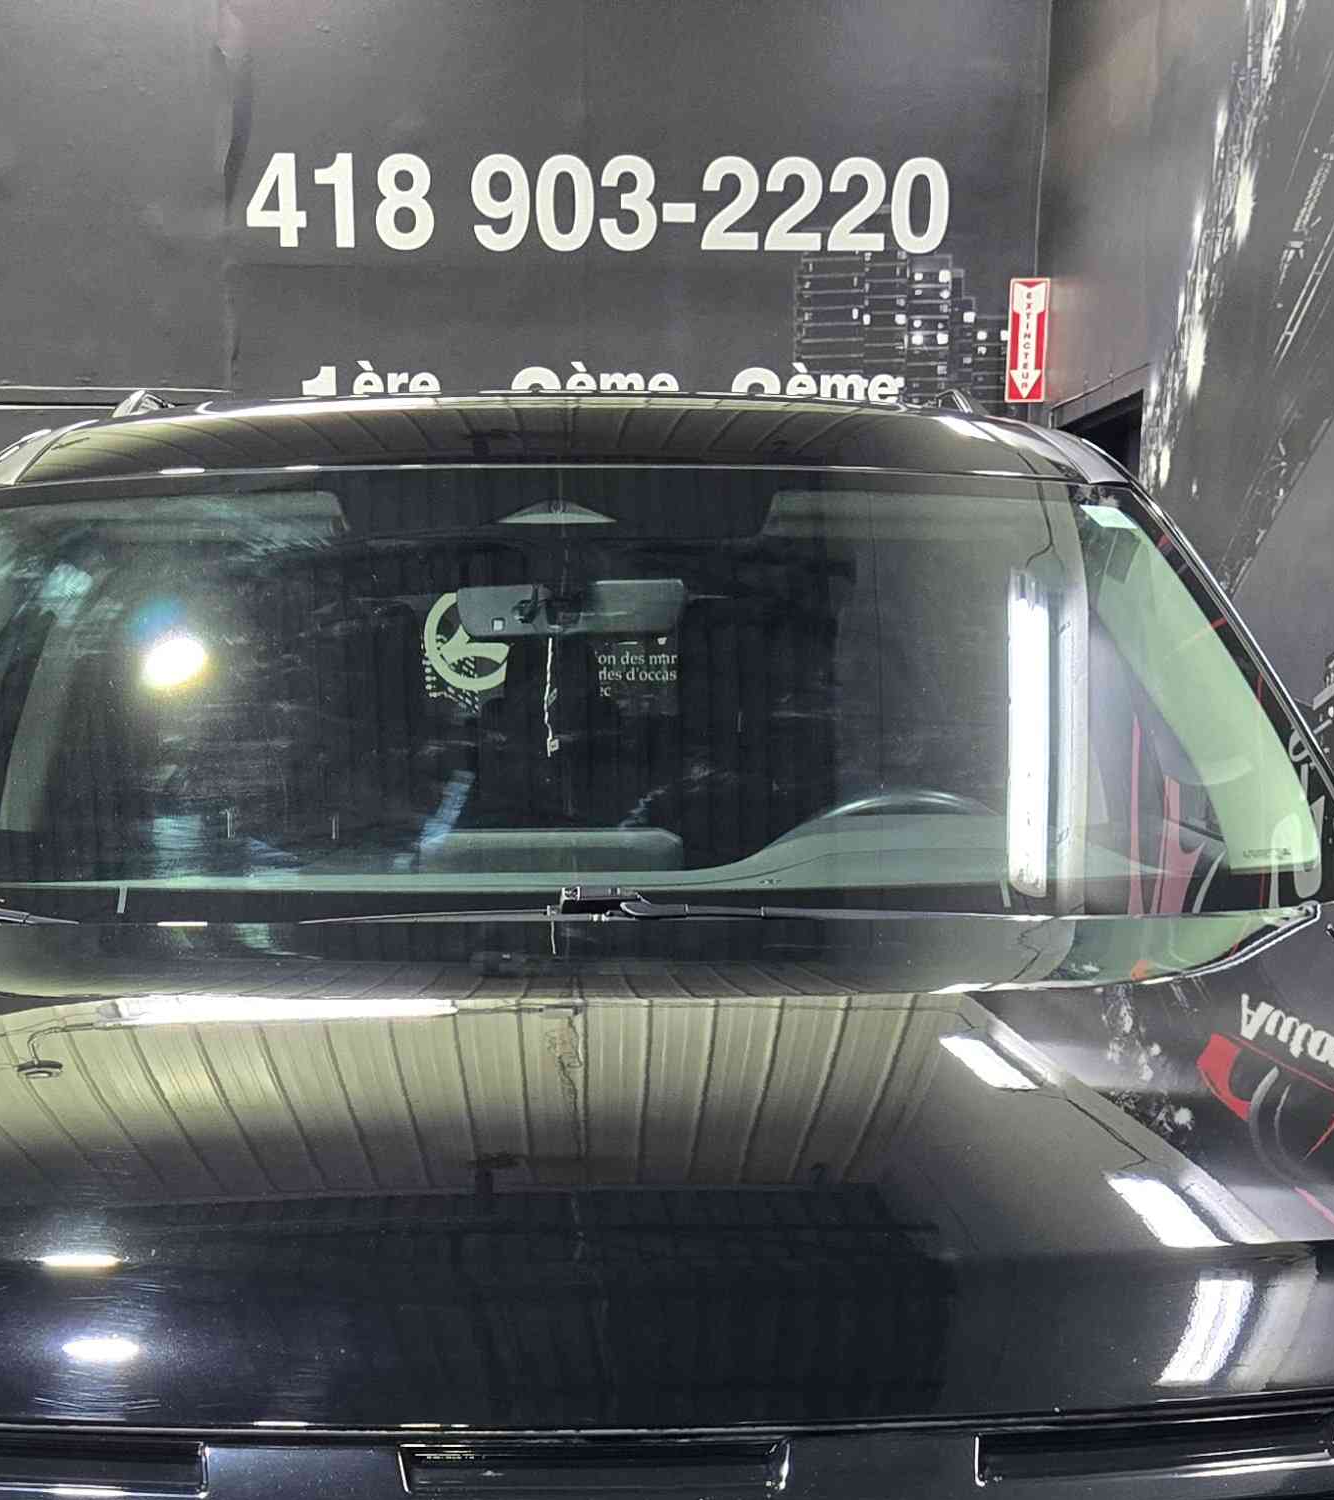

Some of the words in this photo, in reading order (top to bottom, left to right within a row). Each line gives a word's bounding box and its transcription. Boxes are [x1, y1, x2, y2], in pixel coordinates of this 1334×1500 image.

[246, 152, 435, 251] 418
[470, 153, 950, 254] 903-2220
[1020, 291, 1033, 389] EXTINCTEUR
[597, 653, 617, 665] on
[620, 650, 645, 665] des
[649, 653, 678, 665] mar
[625, 666, 678, 681] d'occas
